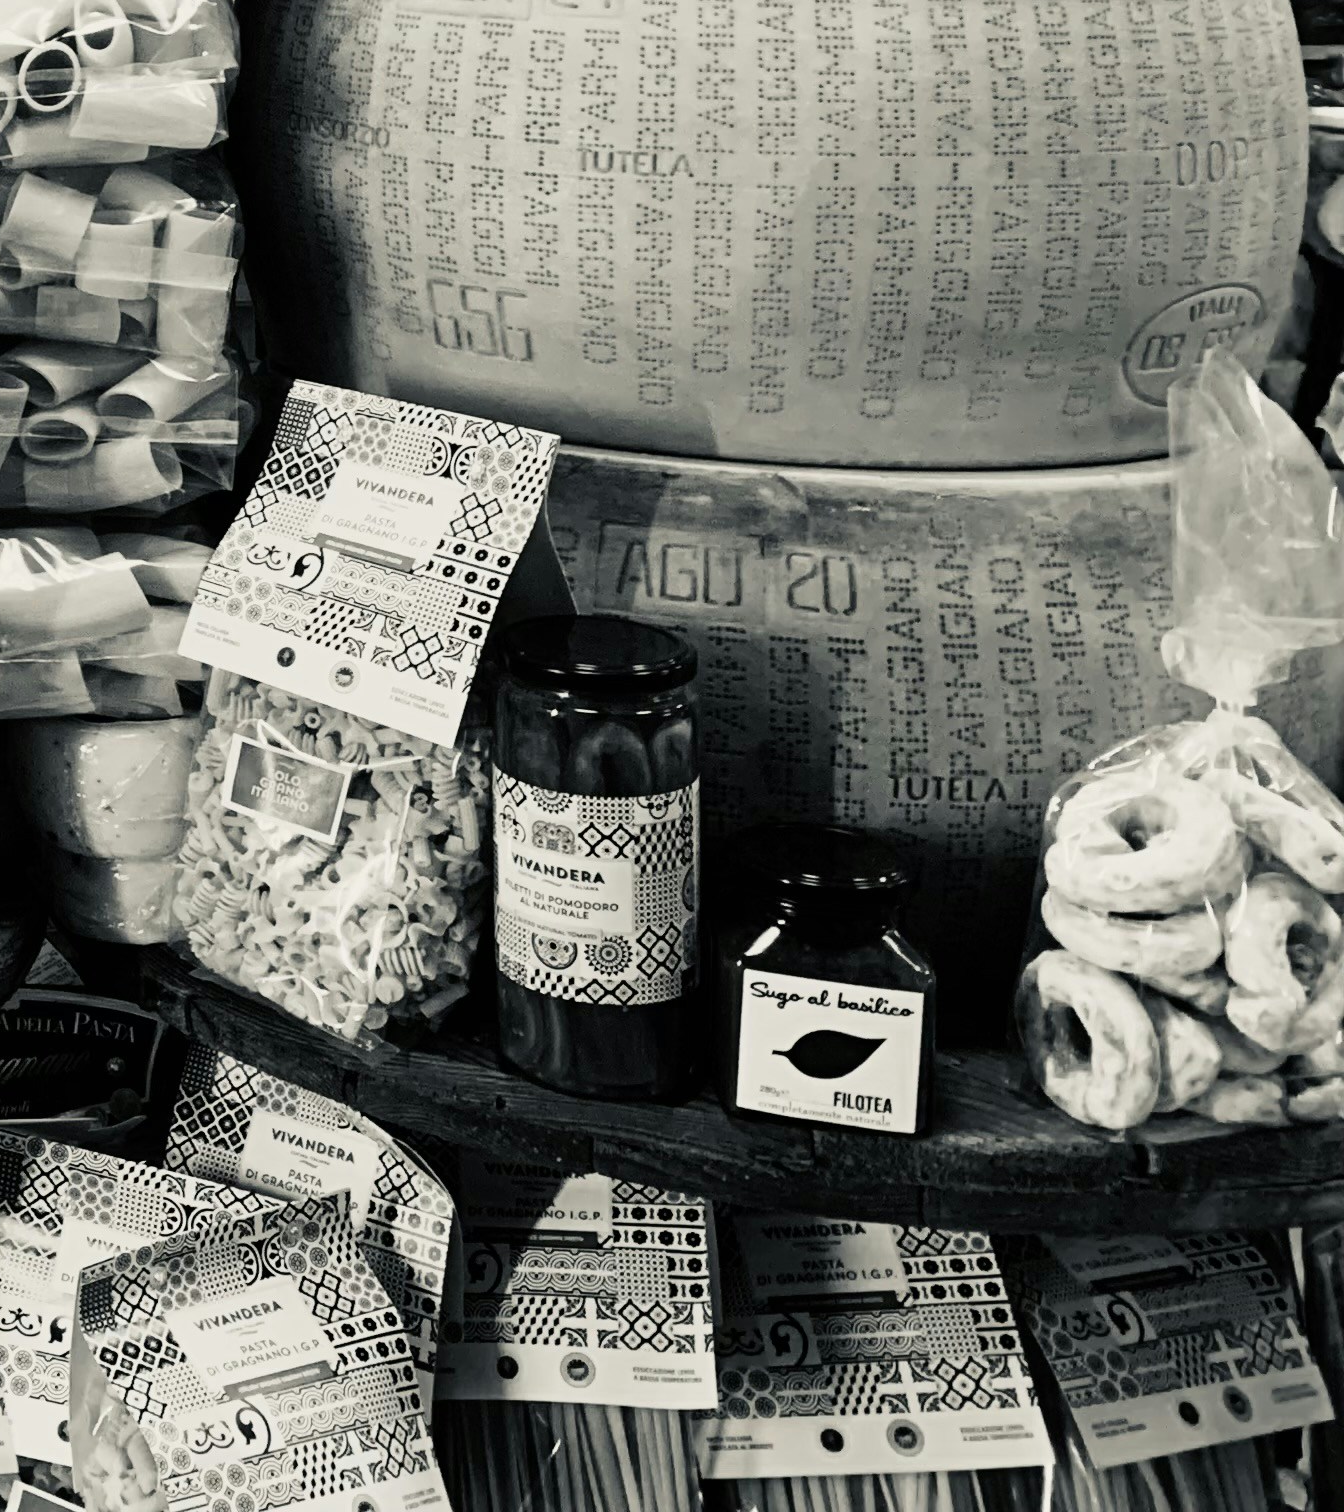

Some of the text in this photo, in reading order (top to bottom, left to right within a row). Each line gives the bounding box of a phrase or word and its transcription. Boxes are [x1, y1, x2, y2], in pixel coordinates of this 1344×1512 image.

[579, 146, 695, 179] TUTELA
[429, 280, 537, 362] 656
[356, 477, 434, 507] VIVANDERA
[785, 551, 858, 616] 20
[890, 777, 1009, 804] TUTELA
[511, 851, 606, 885] VIVANDERA
[533, 901, 590, 920] NATURALE
[548, 894, 620, 913] POMODORO
[750, 981, 915, 1017] Sugo al basilico
[71, 1011, 135, 1045] PASTA
[833, 1091, 893, 1115] FILOTEA
[271, 1127, 356, 1165] VIVANDERA
[245, 1167, 258, 1181] DI
[287, 1168, 323, 1188] PASTA
[761, 1222, 867, 1241] VIVANDERA
[775, 1270, 858, 1285] GRAGNANO
[801, 1259, 845, 1272] PASTA
[192, 1299, 285, 1332] VIVANDERA
[239, 1338, 278, 1355] PASTA
[205, 1347, 292, 1377] DI GRAGNANO
